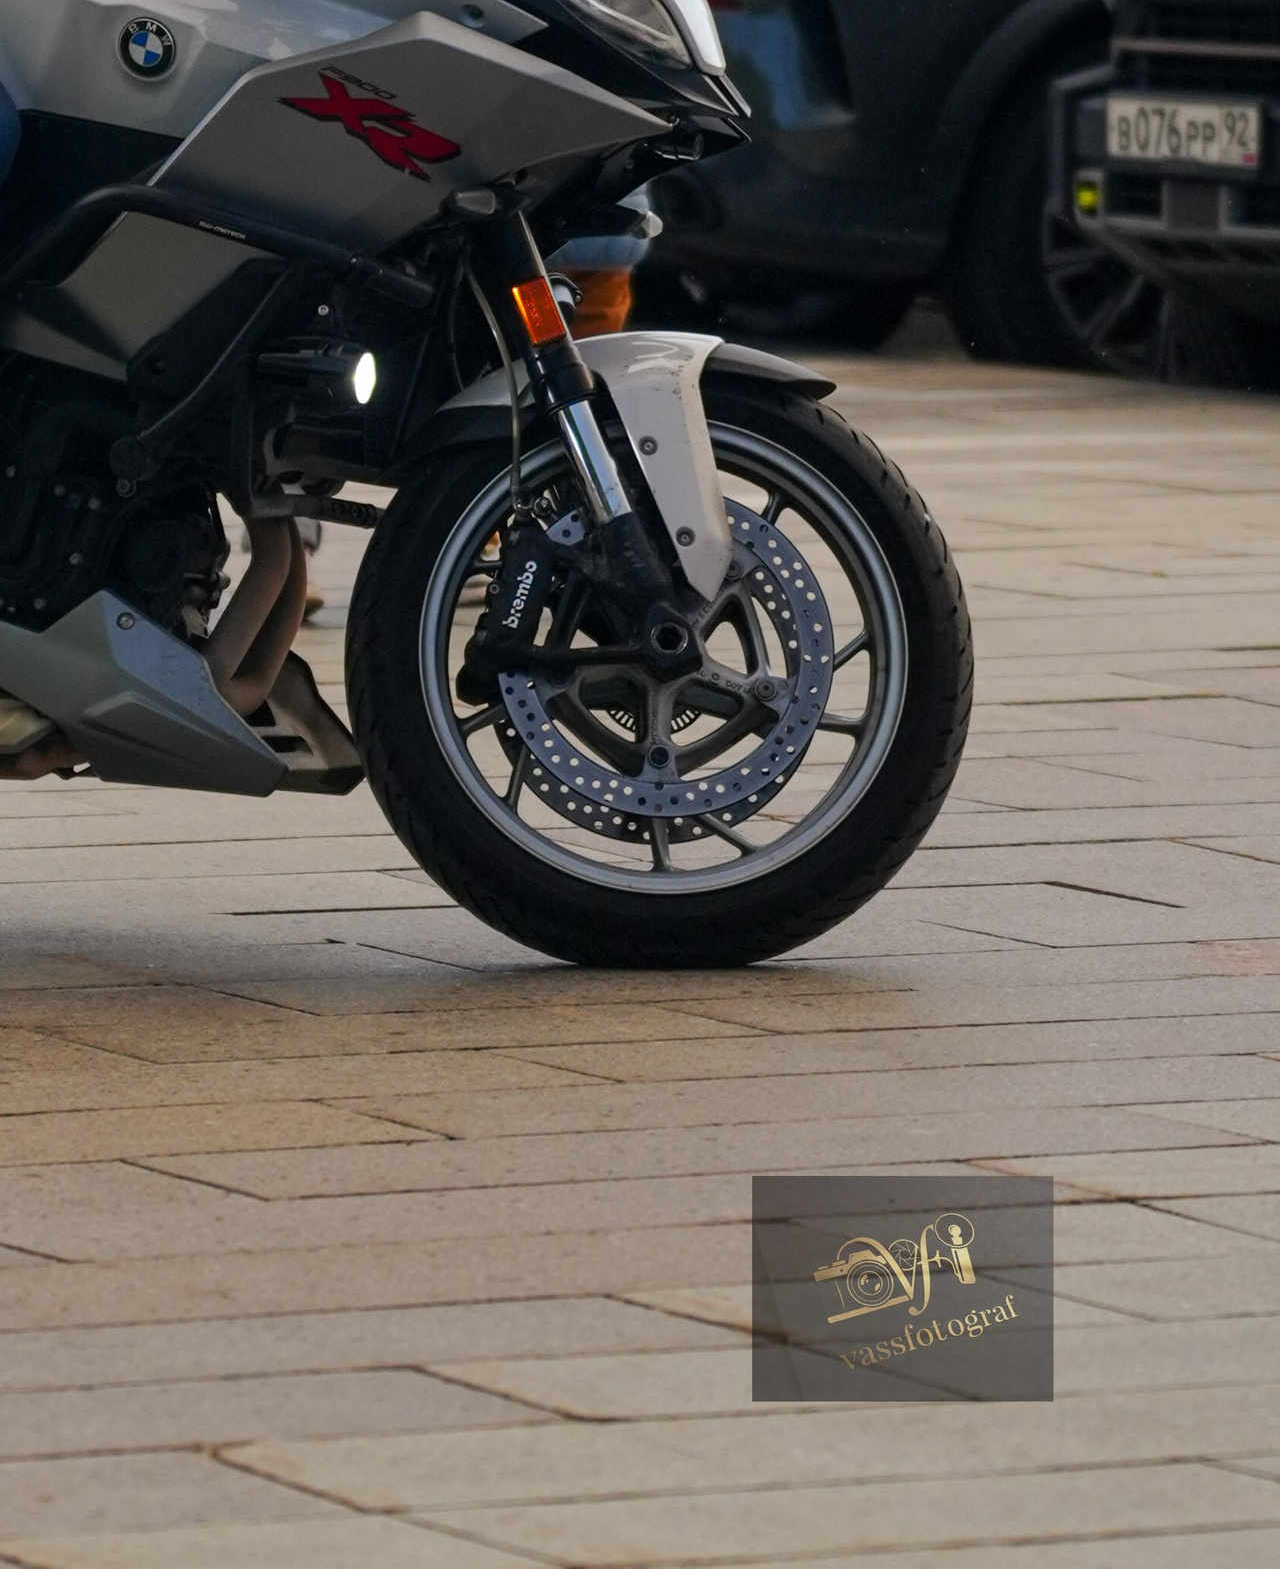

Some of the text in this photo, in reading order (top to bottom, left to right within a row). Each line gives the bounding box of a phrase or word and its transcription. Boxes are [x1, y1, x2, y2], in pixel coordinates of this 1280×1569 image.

[128, 21, 173, 47] BMW
[321, 66, 397, 100] F900
[277, 71, 463, 183] XR
[502, 560, 537, 629] brembo
